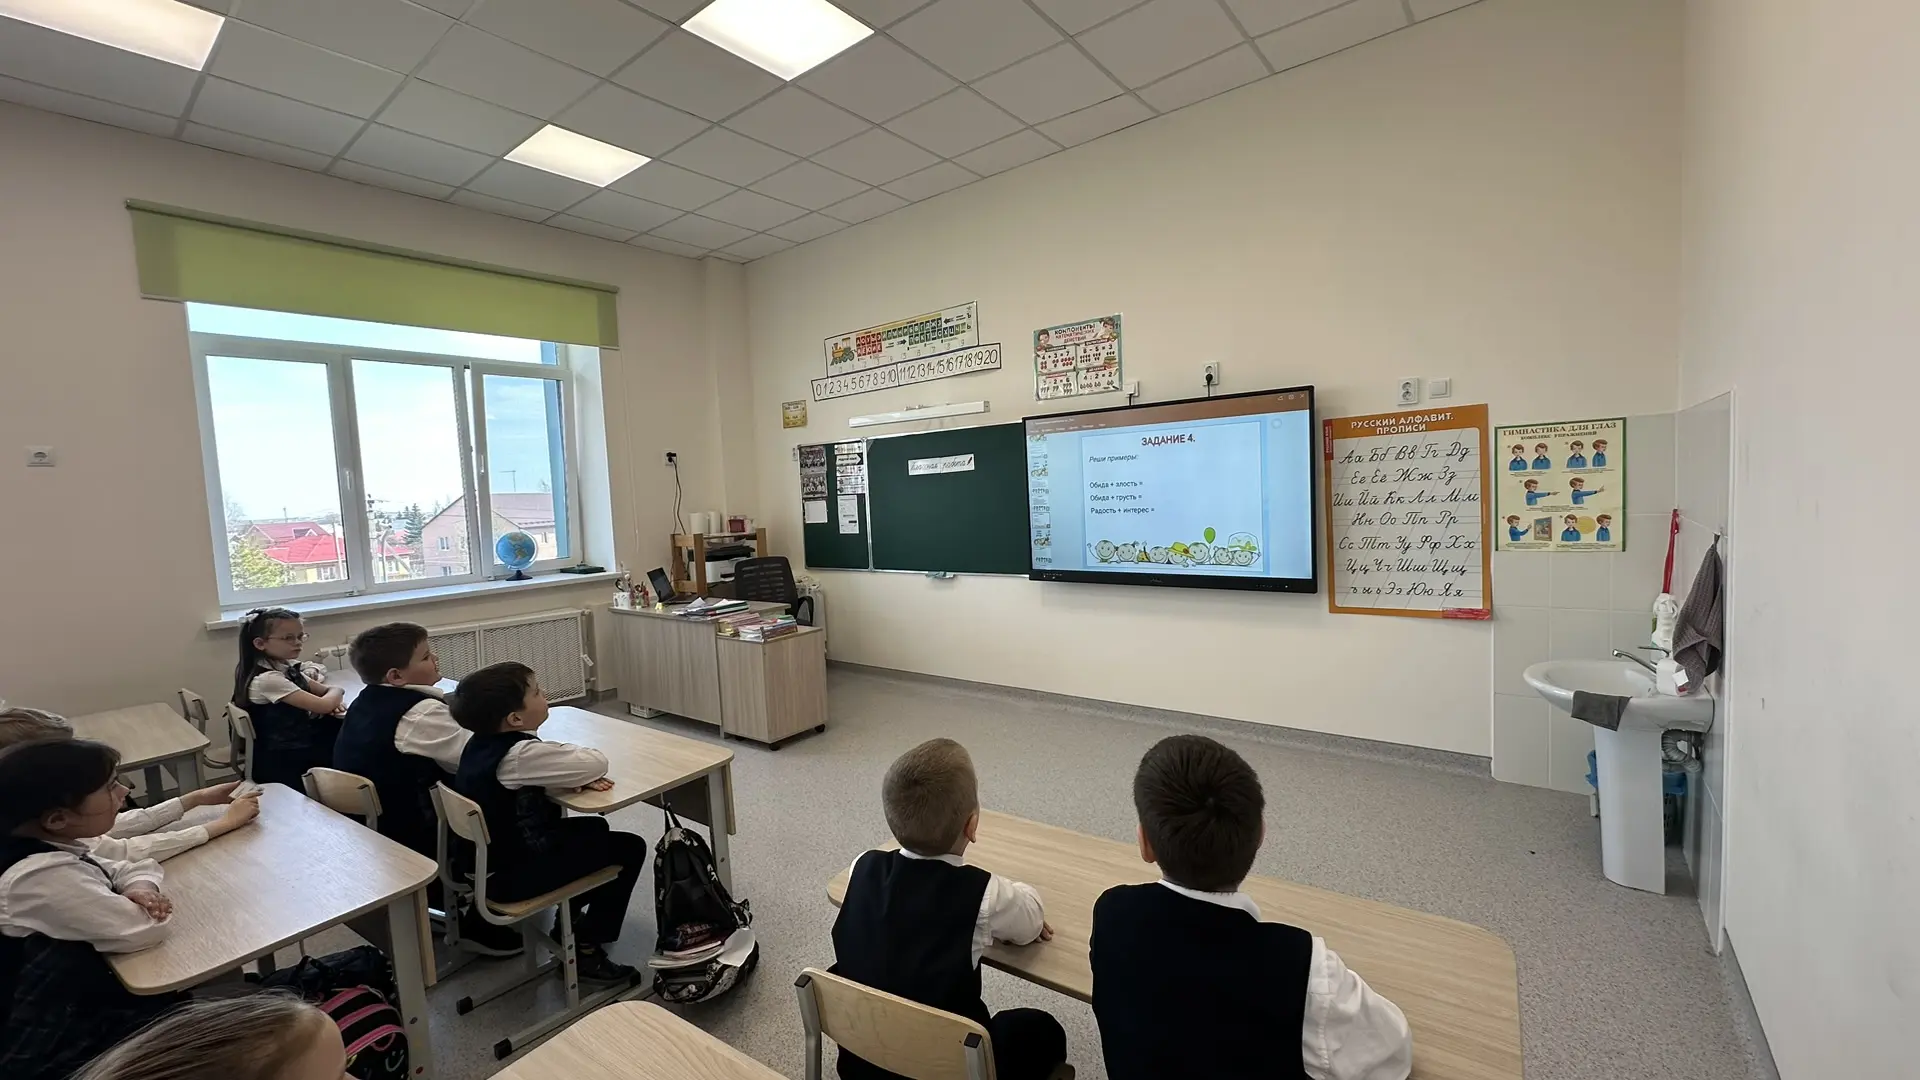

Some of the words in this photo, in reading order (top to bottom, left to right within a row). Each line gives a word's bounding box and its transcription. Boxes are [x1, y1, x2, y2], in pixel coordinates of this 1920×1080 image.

[1055, 323, 1095, 335] КОМПОНЕНТЫ
[816, 384, 821, 396] 0
[824, 383, 827, 394] 1
[829, 382, 834, 393] 2
[836, 380, 841, 392] 3
[843, 379, 848, 391] 4
[851, 377, 857, 390] 5
[859, 376, 864, 388] 6
[866, 375, 871, 387] 7
[873, 373, 878, 385] 8
[880, 371, 885, 384] 9
[887, 369, 896, 382] 10
[900, 367, 906, 380] 11
[907, 365, 915, 378] 12
[917, 363, 925, 377] 13
[927, 362, 935, 375] 14
[936, 359, 945, 374] 15
[946, 357, 954, 371] 16
[955, 355, 963, 369] 17
[964, 352, 973, 368] 18
[974, 350, 983, 366] 19
[984, 349, 998, 364] 20
[1351, 416, 1396, 428] РУССКИЙ
[1399, 412, 1454, 425] АЛФАВИТ.
[1376, 424, 1426, 435] ПРОПИСИ
[1503, 426, 1566, 436] ГИМНАСТИКА
[1568, 423, 1589, 432] ДЛЯ
[1591, 422, 1617, 430] ГЛАЗ
[1141, 434, 1186, 447] ЗАДАНИЕ
[1187, 433, 1196, 443] 4.
[1339, 450, 1364, 464] Аа
[1369, 446, 1397, 462] Бб
[1395, 445, 1418, 461] Вв
[1421, 443, 1440, 459] Гг
[1446, 441, 1470, 463] Дд
[1351, 471, 1367, 485] Ее
[1393, 467, 1434, 482] Жж
[1438, 465, 1457, 486] Зз
[1089, 481, 1109, 489] Обида
[1090, 494, 1109, 502] Обида
[1116, 494, 1137, 502] грусть
[1333, 492, 1354, 507] Ии
[1358, 489, 1379, 506] Йй
[1383, 490, 1405, 505] Кк
[1408, 490, 1437, 504] Лл
[1091, 507, 1116, 515] Радость
[1351, 512, 1375, 526] Нн
[1379, 512, 1397, 526] Оо
[1401, 511, 1429, 525] Пп
[1435, 510, 1459, 529] Рр
[1338, 536, 1354, 550] Сс
[1358, 536, 1391, 550] Тт
[1394, 535, 1413, 555] Уу
[1416, 535, 1442, 555] Фф
[1345, 558, 1370, 575] Цц
[1373, 558, 1392, 572] Чч
[1396, 558, 1427, 572] Шш
[1431, 558, 1467, 576] Щщ
[1384, 581, 1403, 595] Ээ
[1406, 582, 1434, 596] Юю
[1438, 582, 1464, 597] Яя
